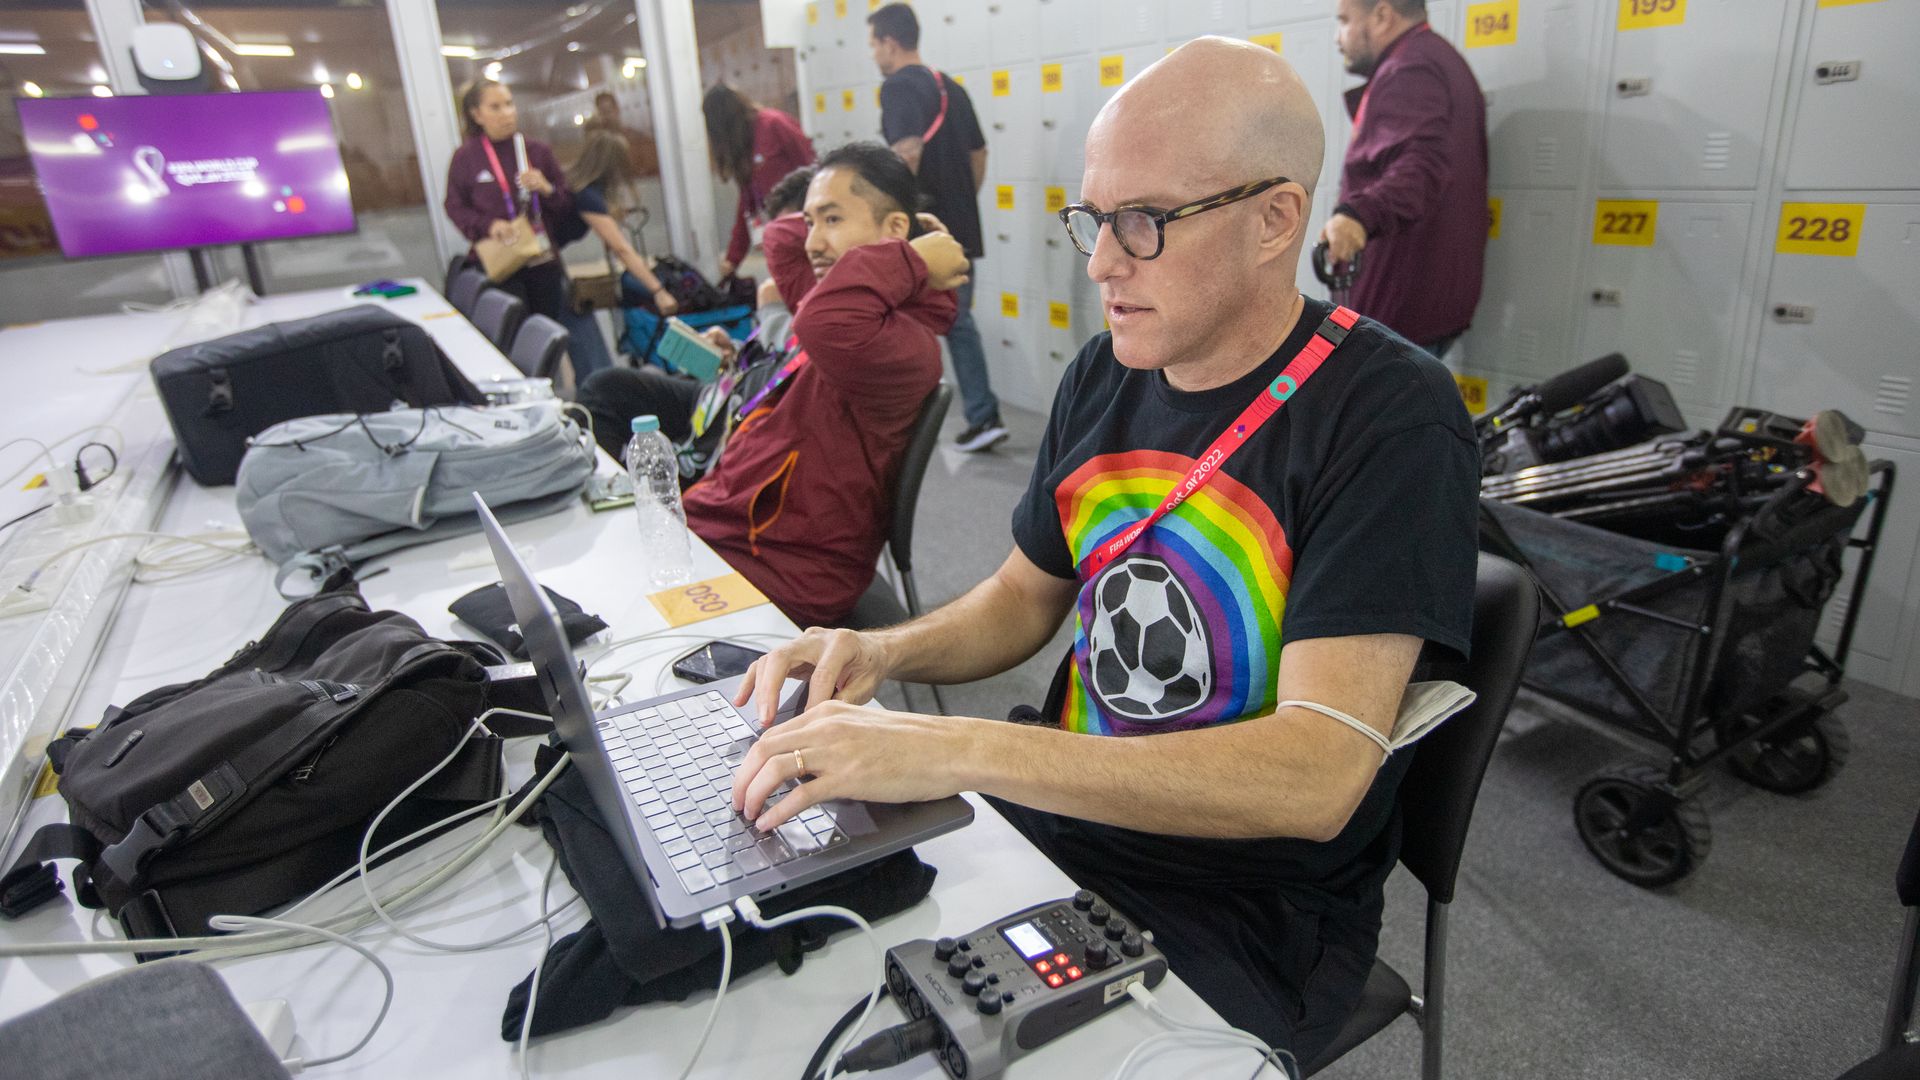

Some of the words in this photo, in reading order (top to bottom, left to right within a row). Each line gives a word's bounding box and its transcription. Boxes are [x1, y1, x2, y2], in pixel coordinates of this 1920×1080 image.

[1473, 12, 1510, 36] 194
[1601, 211, 1649, 235] 227
[1787, 216, 1851, 243] 228
[1109, 539, 1125, 555] FIFA
[685, 584, 729, 613] 030
